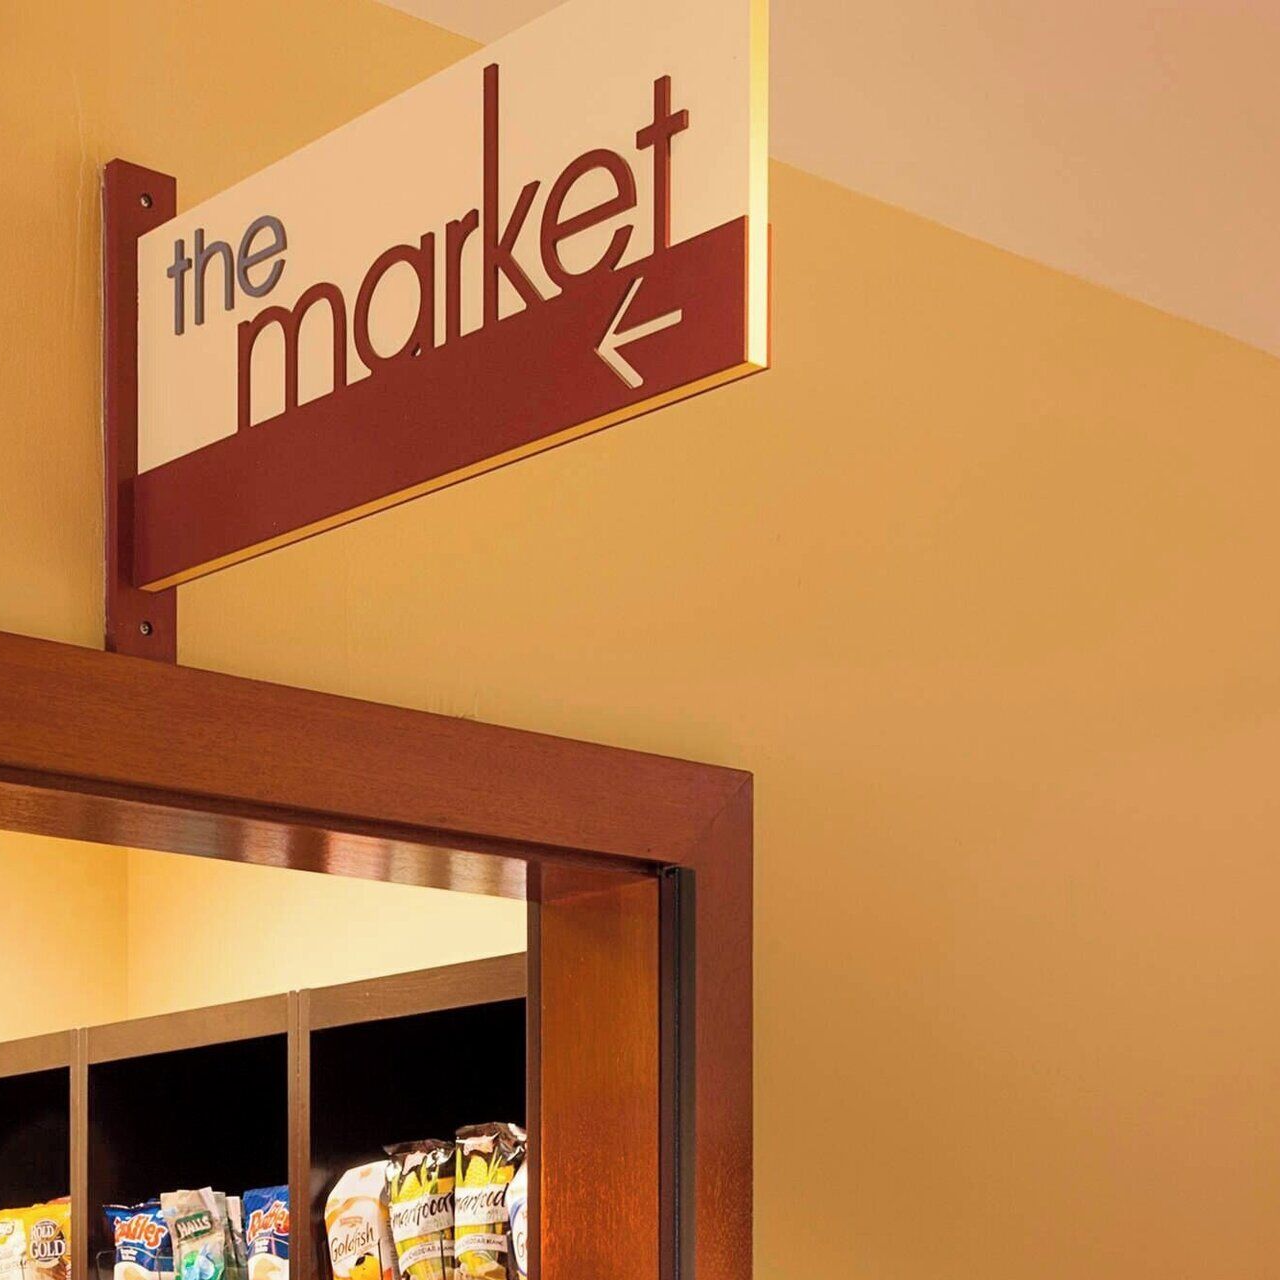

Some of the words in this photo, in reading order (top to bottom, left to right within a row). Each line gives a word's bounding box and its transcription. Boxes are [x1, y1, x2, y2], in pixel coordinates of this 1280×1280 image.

[236, 62, 690, 432] market
[166, 214, 288, 336] the
[177, 1214, 213, 1238] HALLS
[331, 1222, 375, 1262] Goldfish
[30, 1239, 66, 1260] GOLD
